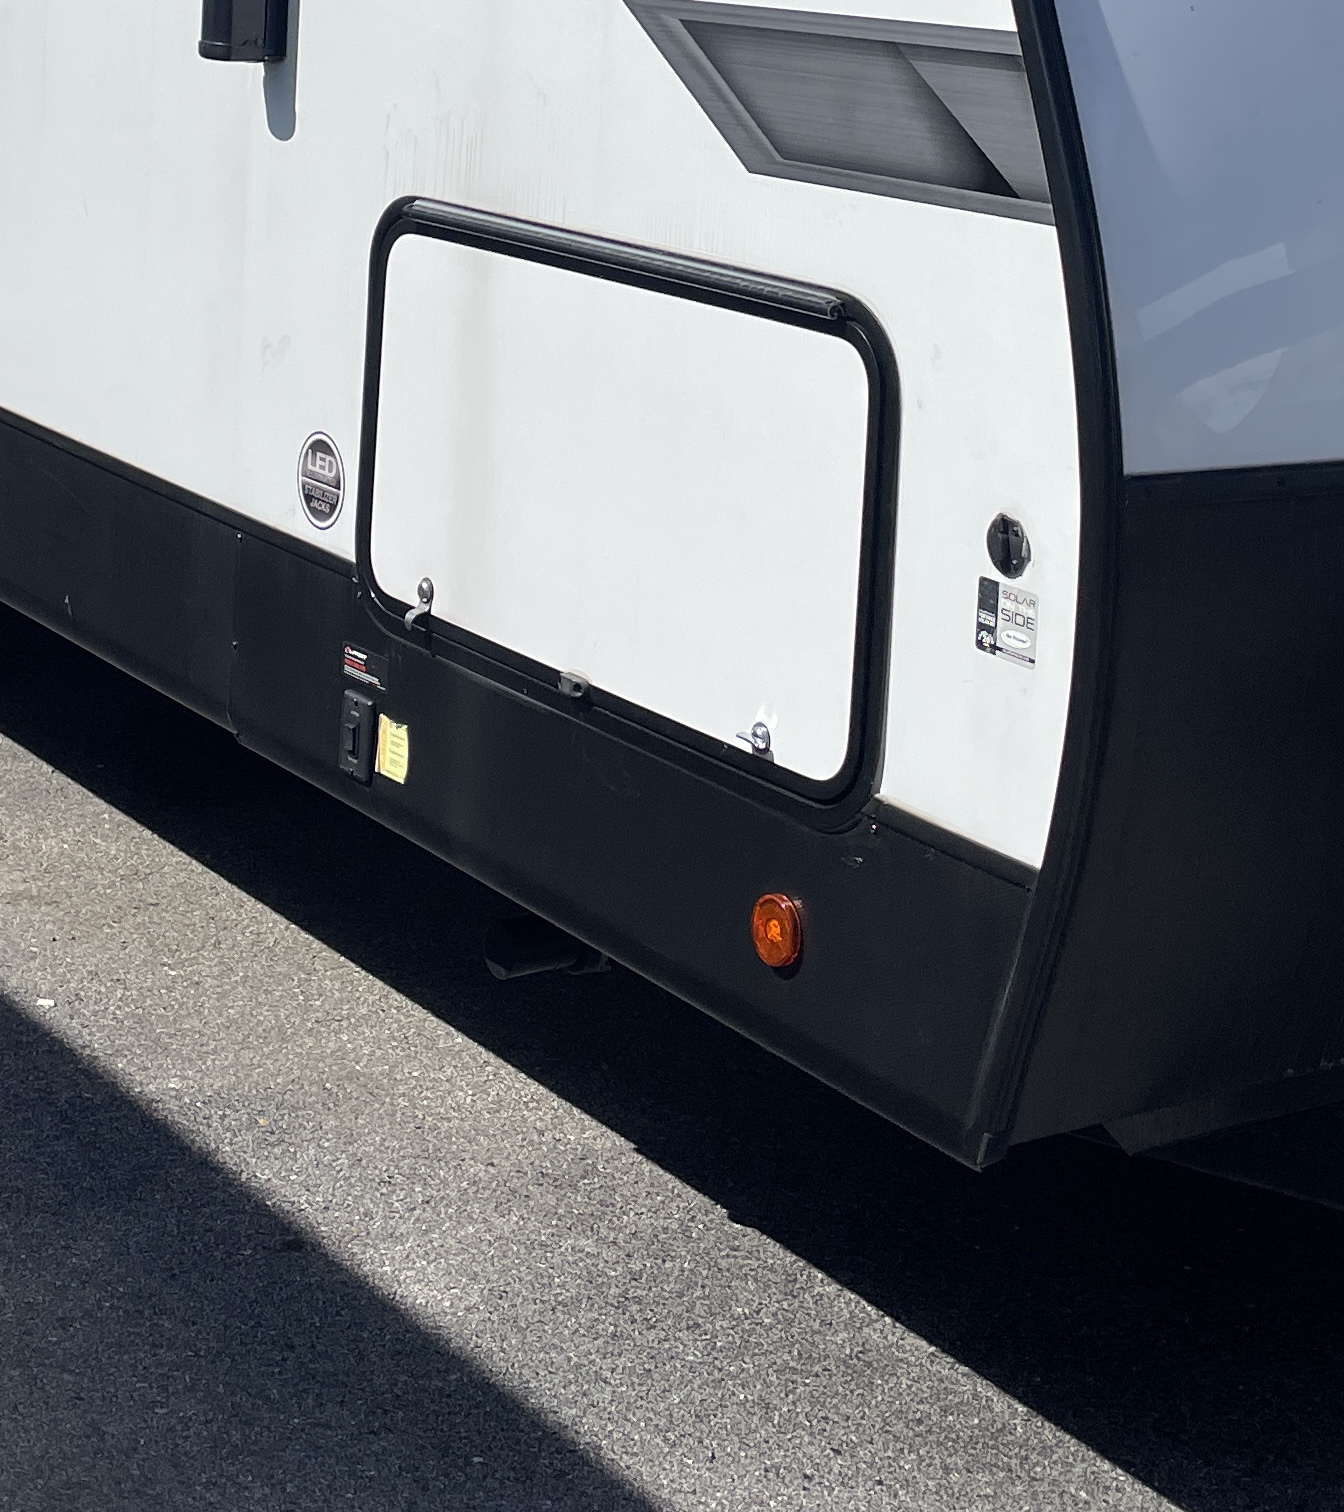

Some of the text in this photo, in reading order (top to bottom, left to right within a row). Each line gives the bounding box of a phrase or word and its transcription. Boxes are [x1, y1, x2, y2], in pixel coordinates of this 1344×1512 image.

[307, 448, 337, 478] LED
[1001, 589, 1036, 607] SOLAR
[1000, 607, 1035, 632] SIDE
